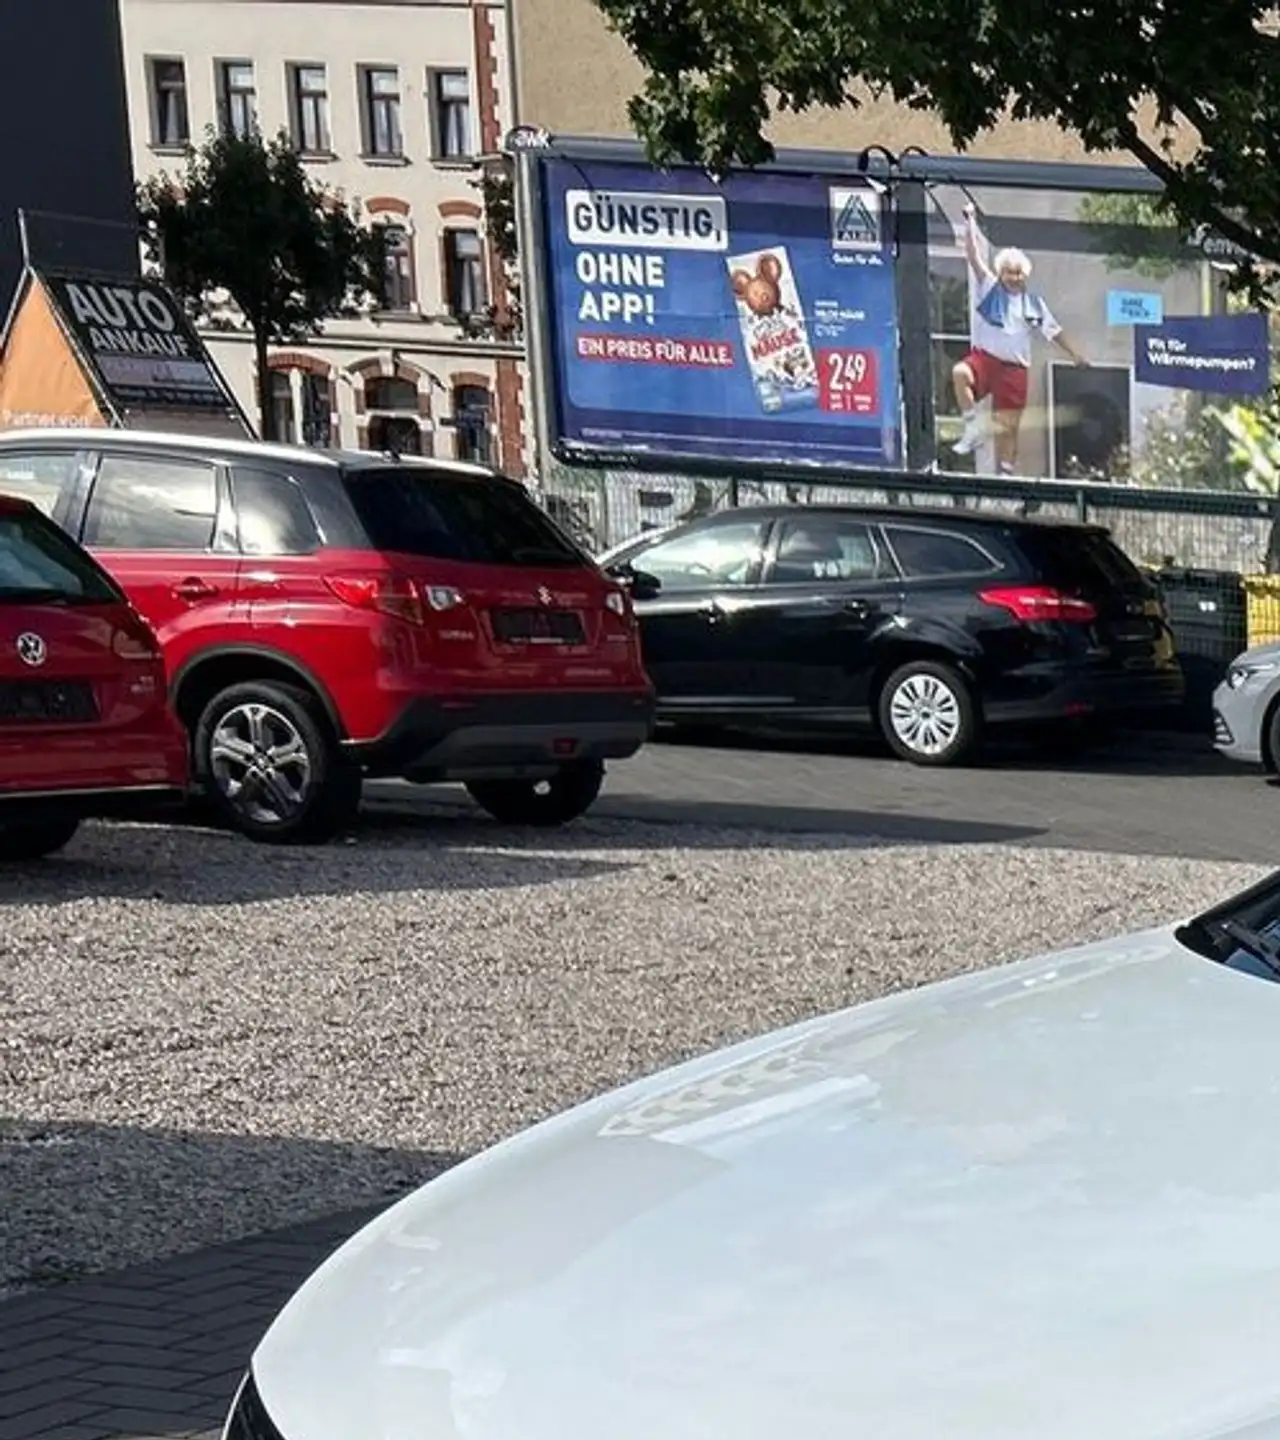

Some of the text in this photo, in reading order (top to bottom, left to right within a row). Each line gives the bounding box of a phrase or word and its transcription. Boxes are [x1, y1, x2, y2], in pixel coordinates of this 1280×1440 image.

[574, 195, 722, 242] GÜNSTIG,
[576, 252, 665, 288] OHNE
[65, 284, 175, 331] AUTO
[578, 291, 655, 325] APP!
[89, 327, 190, 357] ANKAUF
[578, 337, 734, 365] EIN PREIS FÜR ALLE.
[1147, 350, 1256, 371] Wärmepumpen?
